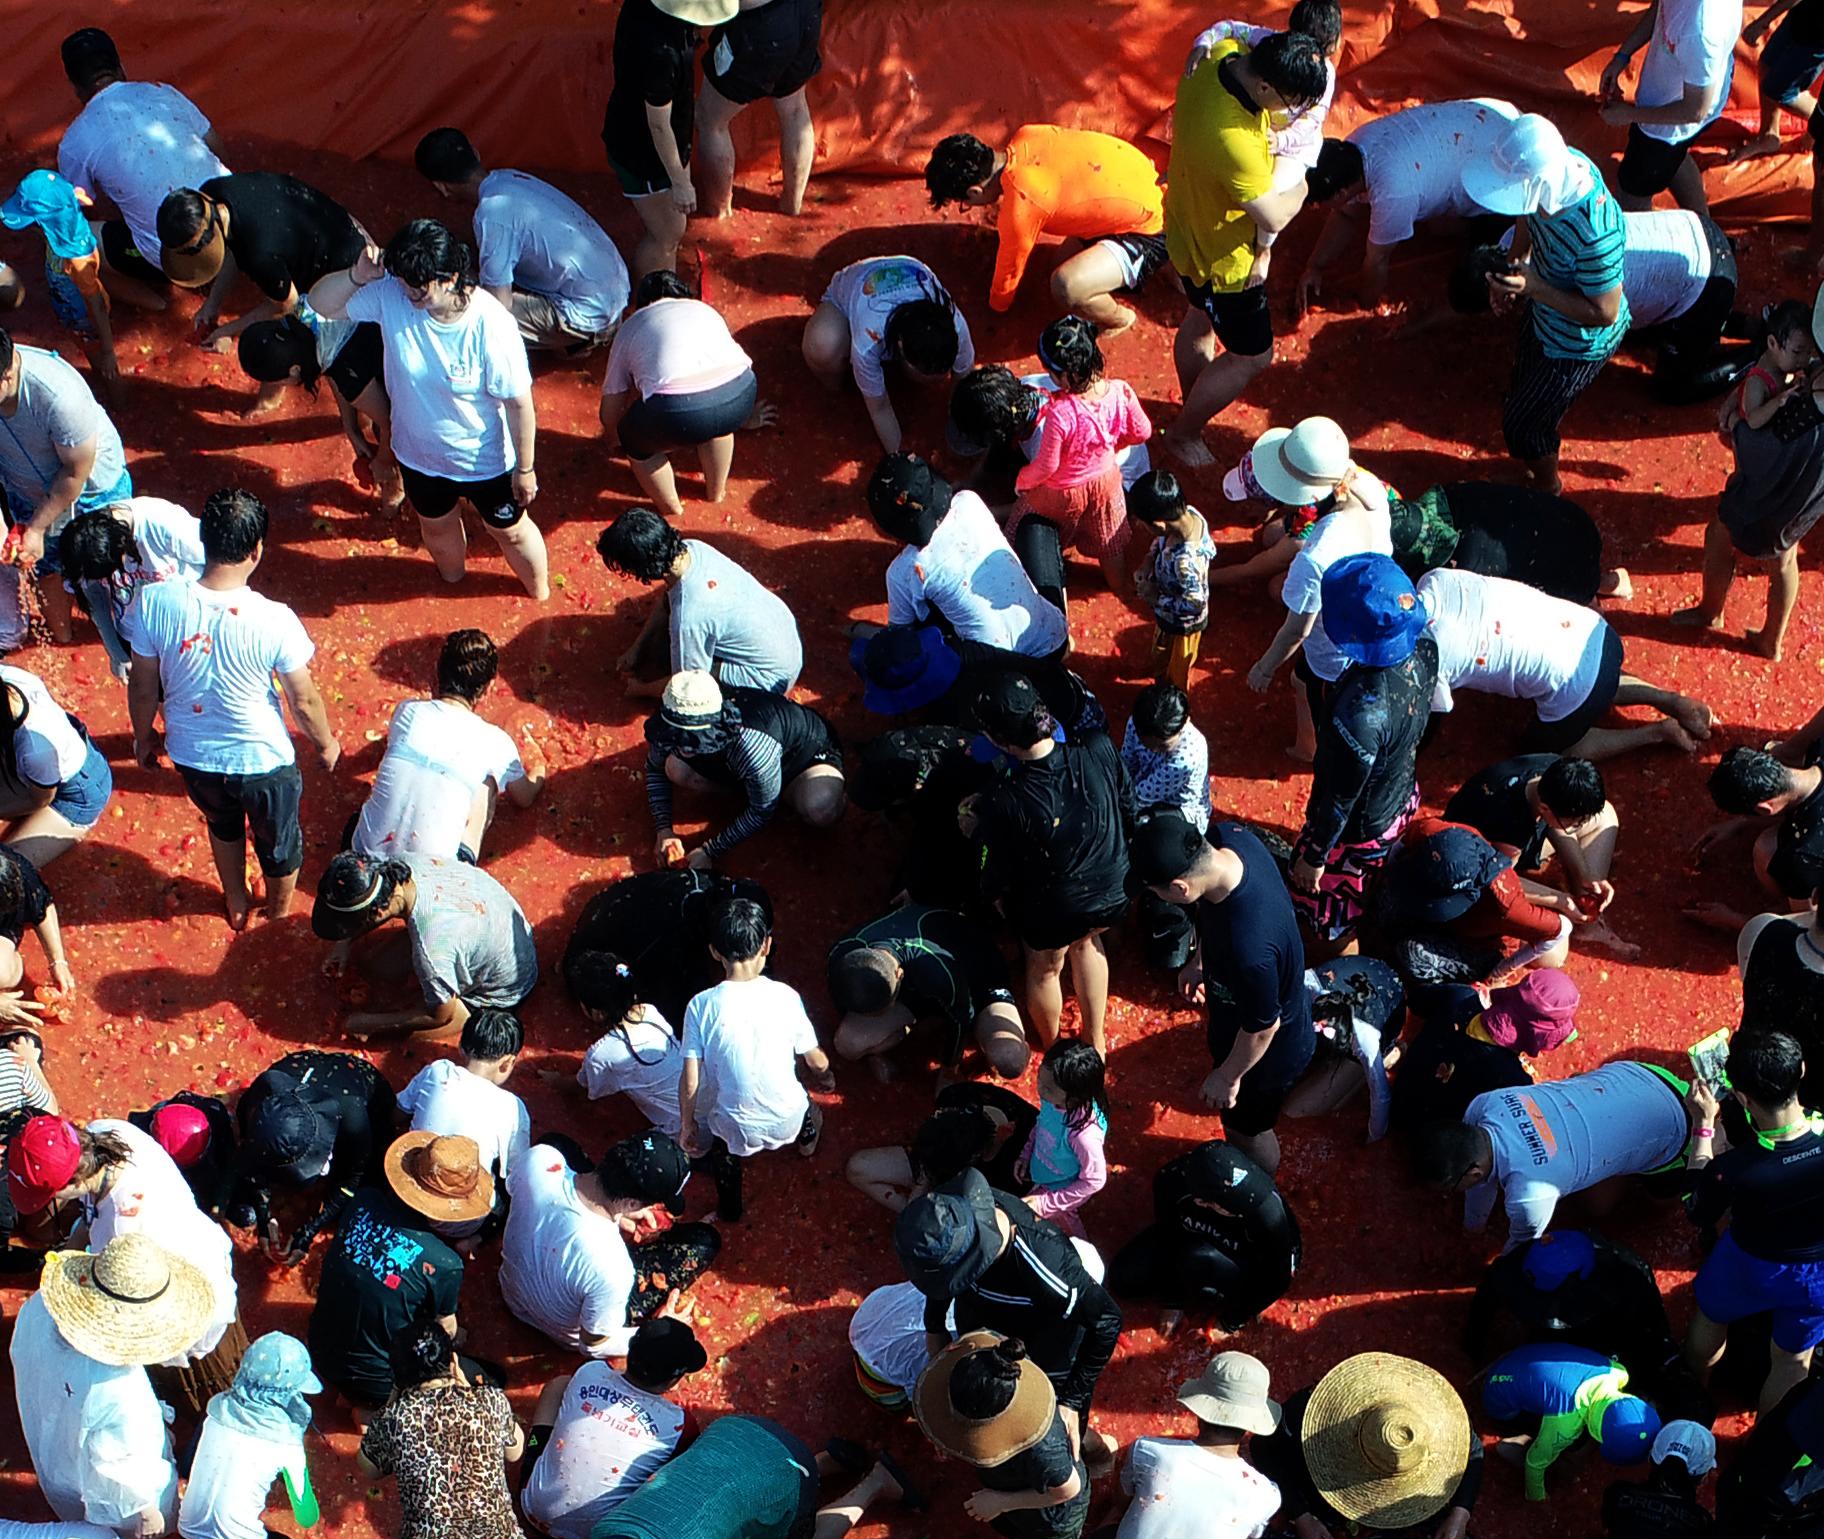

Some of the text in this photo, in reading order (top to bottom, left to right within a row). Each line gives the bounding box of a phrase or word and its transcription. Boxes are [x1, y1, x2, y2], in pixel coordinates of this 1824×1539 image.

[1500, 1093, 1550, 1167] SUMMER SURF
[1782, 1146, 1822, 1165] DESCENTE
